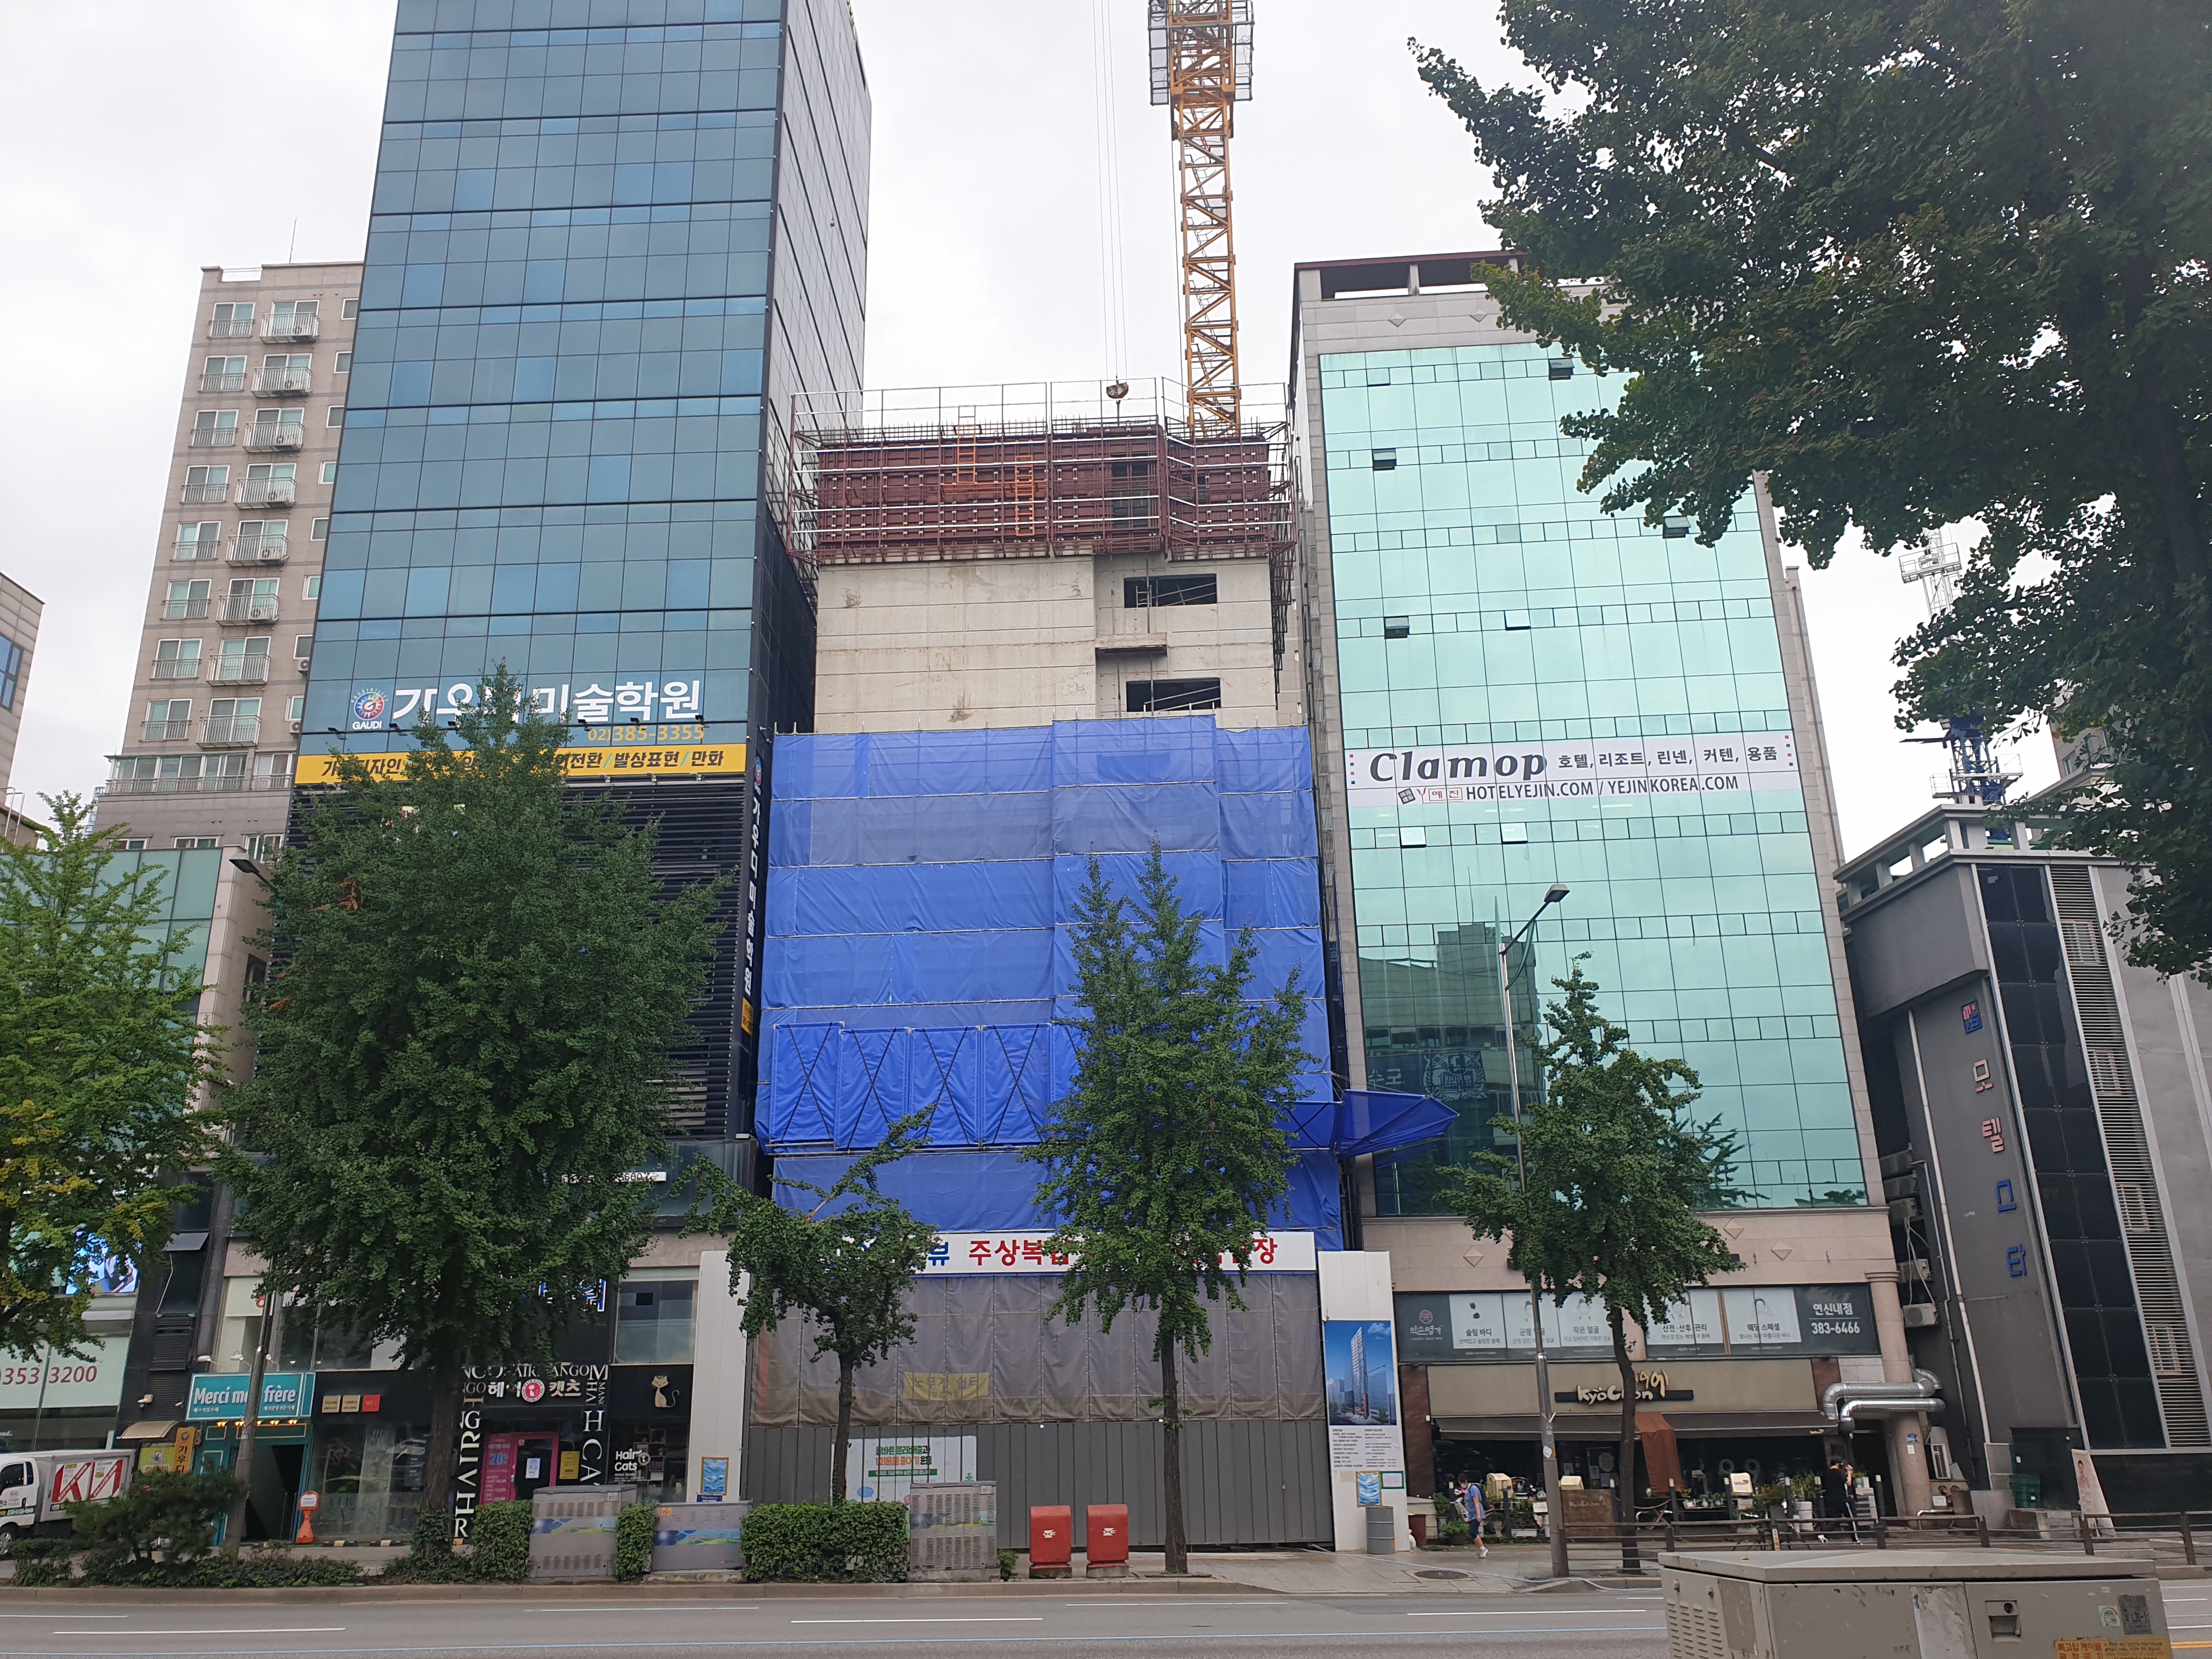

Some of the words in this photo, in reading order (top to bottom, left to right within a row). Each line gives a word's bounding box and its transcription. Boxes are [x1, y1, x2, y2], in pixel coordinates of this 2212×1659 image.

[532, 680, 700, 724] 미술학원
[352, 720, 383, 731] GAUDI
[588, 724, 705, 742] 02)385-3355
[614, 751, 680, 769] 발상표현
[691, 751, 724, 766] 만화
[1558, 754, 1594, 769] 호텔,
[1599, 752, 1651, 767] 리조트,
[1657, 749, 1693, 765] 린넨,
[1703, 747, 1739, 763] 커텐,
[1747, 746, 1778, 761] 용품
[1369, 751, 1548, 782] Clamop
[1466, 781, 1593, 800] HOTELYEJIN.COM
[1607, 775, 1739, 795] YEJINKOREA.COM
[1813, 1302, 1853, 1316] 연신내점
[1465, 1328, 1478, 1336] 슬림
[1480, 1328, 1492, 1336] 바디
[1572, 1326, 1586, 1334] 작은
[1587, 1325, 1599, 1334] 얼굴
[1695, 1323, 1707, 1331] 관리
[1762, 1323, 1780, 1331] 스페셜
[1811, 1321, 1860, 1335] 383-6466
[2, 1367, 40, 1385] 353
[48, 1365, 98, 1383] 3200
[193, 1386, 231, 1404] Merci
[263, 1385, 296, 1403] frère
[549, 1379, 582, 1397] 캣츠
[616, 1448, 642, 1460] Hair
[614, 1461, 637, 1471] Cats
